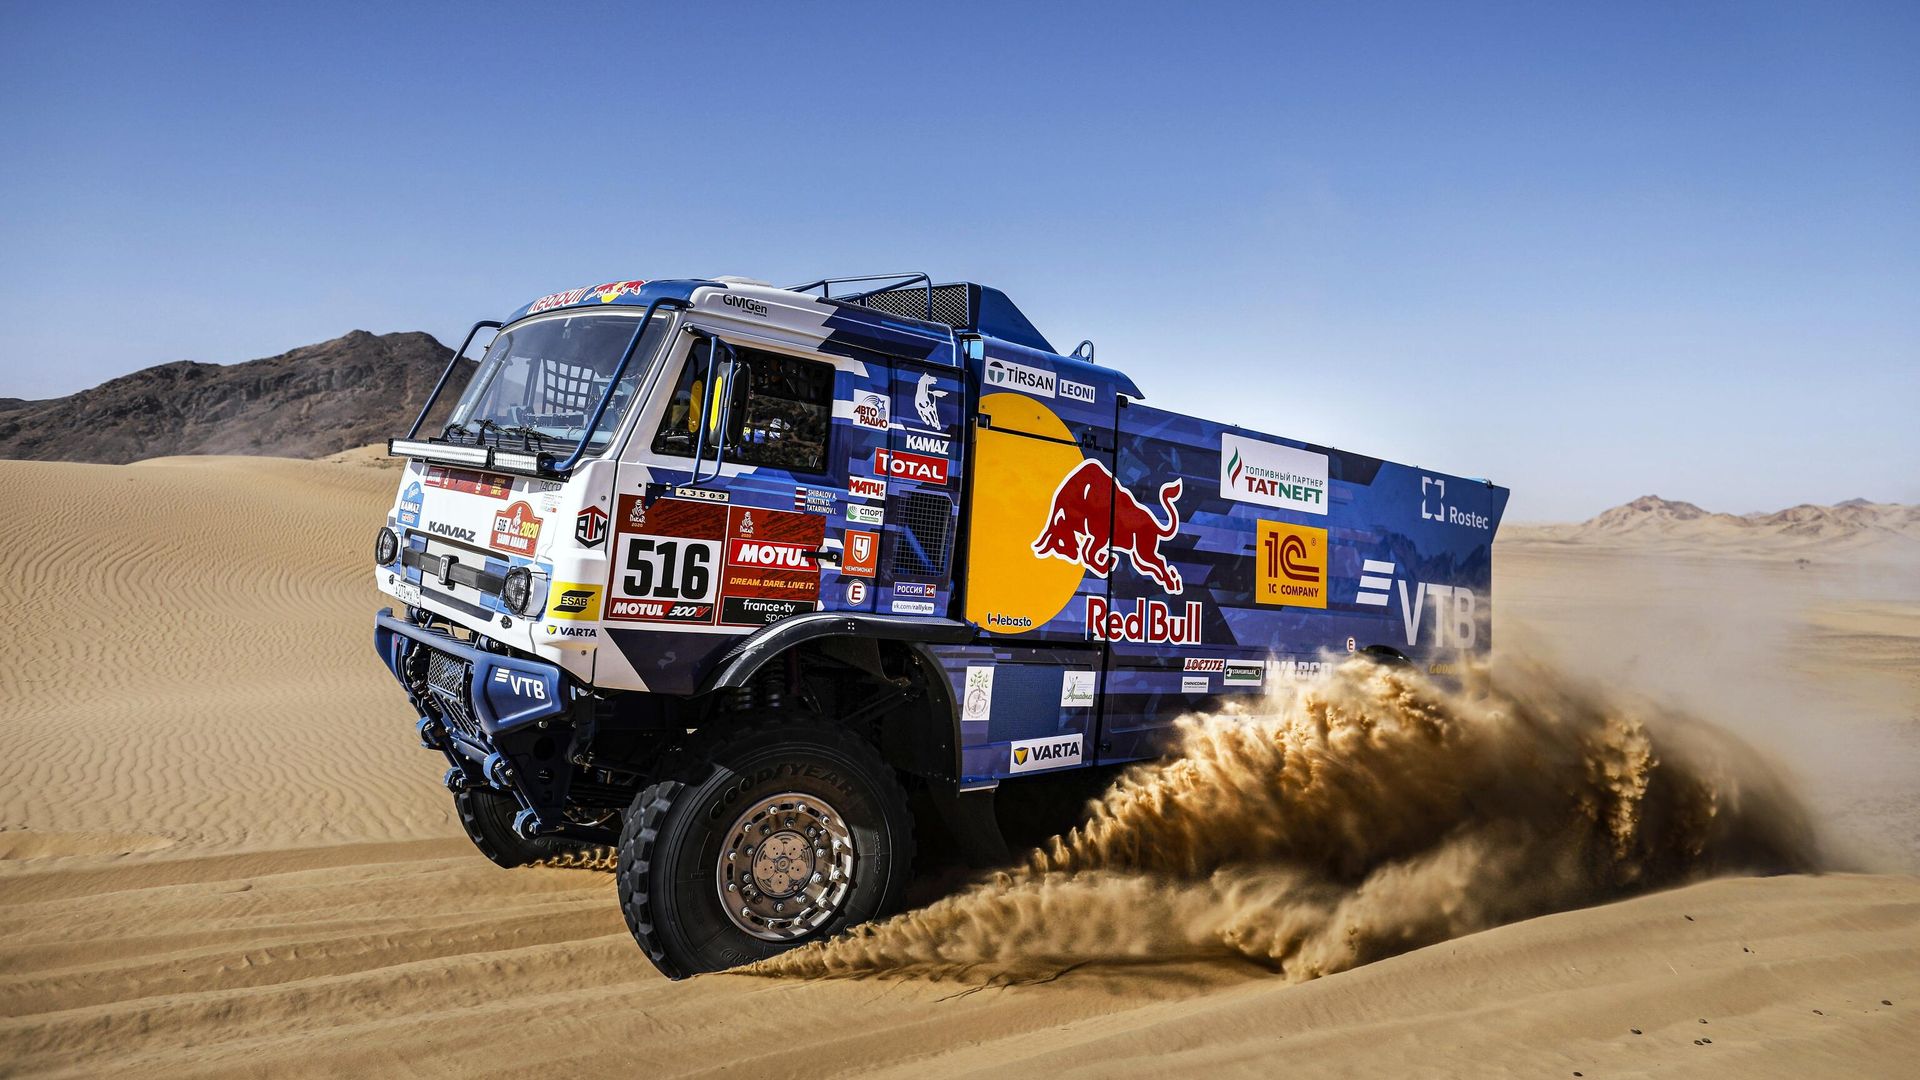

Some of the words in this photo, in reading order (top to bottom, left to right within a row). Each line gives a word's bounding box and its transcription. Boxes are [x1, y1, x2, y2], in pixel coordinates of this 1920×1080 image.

[723, 294, 767, 314] GMGen
[1061, 382, 1094, 400] LEONI
[854, 405, 877, 416] АВТО
[860, 414, 887, 428] РАДИО
[906, 435, 949, 455] KAMAZ
[879, 453, 944, 480] TOTAL
[1245, 465, 1291, 482] ТОПЛИВНЫЙ
[1292, 476, 1324, 487] ПАРТНЕР
[680, 489, 726, 500] 43509
[808, 489, 832, 499] SHIBALOV
[849, 479, 884, 497] МАТЧ!
[1245, 476, 1323, 504] TATNEFT
[806, 504, 834, 514] TATARINOV
[807, 497, 825, 506] NIKITIN
[860, 508, 883, 519] СПОРТ
[1450, 506, 1489, 530] Rostec
[428, 521, 476, 542] KAMAZ
[519, 521, 540, 538] 2020
[737, 543, 810, 567] MOTUL
[623, 538, 710, 600] 516
[730, 577, 762, 586] DREAM.
[763, 580, 786, 588] DARE.
[787, 581, 805, 589] LIVE
[805, 582, 815, 590] IT.
[897, 585, 923, 594] РОССИЯ
[1281, 584, 1320, 598] COMPANY
[852, 585, 862, 600] E
[561, 596, 588, 606] ESAB
[613, 602, 664, 616] MOTUL
[668, 605, 711, 618] 300V
[1398, 579, 1476, 649] VTB
[765, 613, 792, 623] spo
[987, 612, 1032, 627] Webasto
[560, 627, 597, 638] VARTA
[1185, 658, 1224, 671] LOCTITE
[510, 675, 545, 700] VTB
[1031, 742, 1079, 761] VARTA
